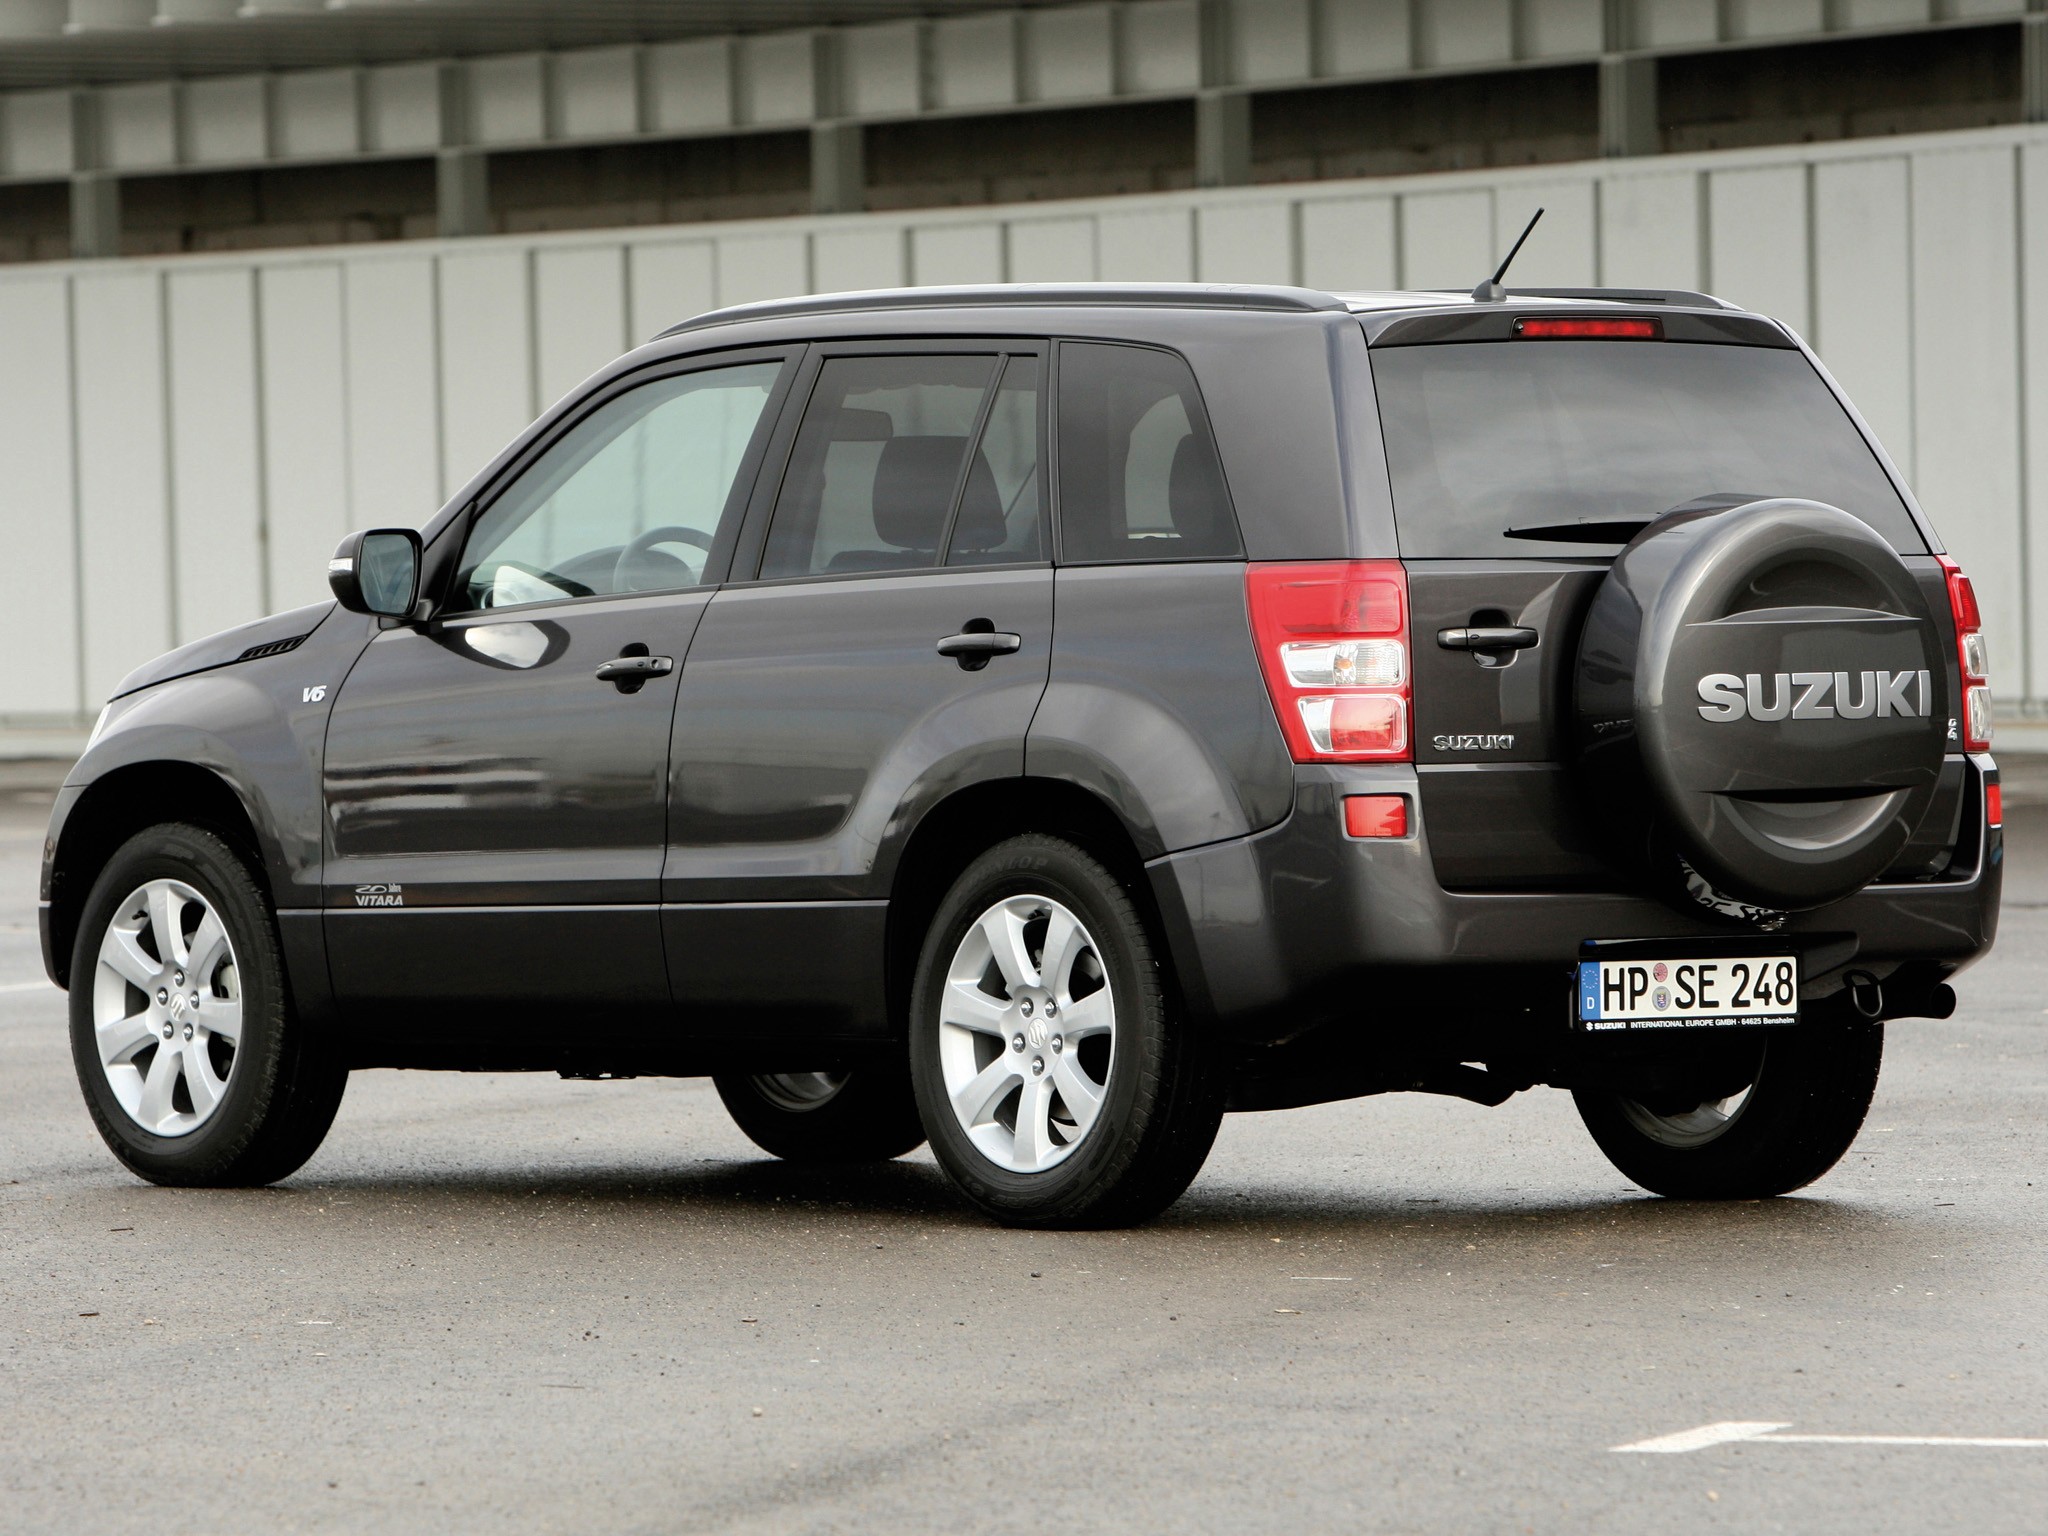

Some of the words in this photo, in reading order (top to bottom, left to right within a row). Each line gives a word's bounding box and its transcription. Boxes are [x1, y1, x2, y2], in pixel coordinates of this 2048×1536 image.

[302, 685, 327, 703] V6
[1697, 669, 1932, 723] SUZUKI
[1432, 734, 1515, 751] SUZUKI
[354, 894, 404, 906] VITARA
[1603, 966, 1649, 1012] HP
[1674, 964, 1720, 1010] SE
[1731, 961, 1794, 1008] 248
[1586, 996, 1596, 1010] D
[1594, 1021, 1627, 1030] SUZUKI
[1630, 1020, 1685, 1029] INTERNATIONAL
[1685, 1019, 1714, 1027] EUROPE
[1715, 1018, 1737, 1026] GMBH
[1741, 1017, 1762, 1025] 64625
[1763, 1016, 1795, 1025] Bensheim
